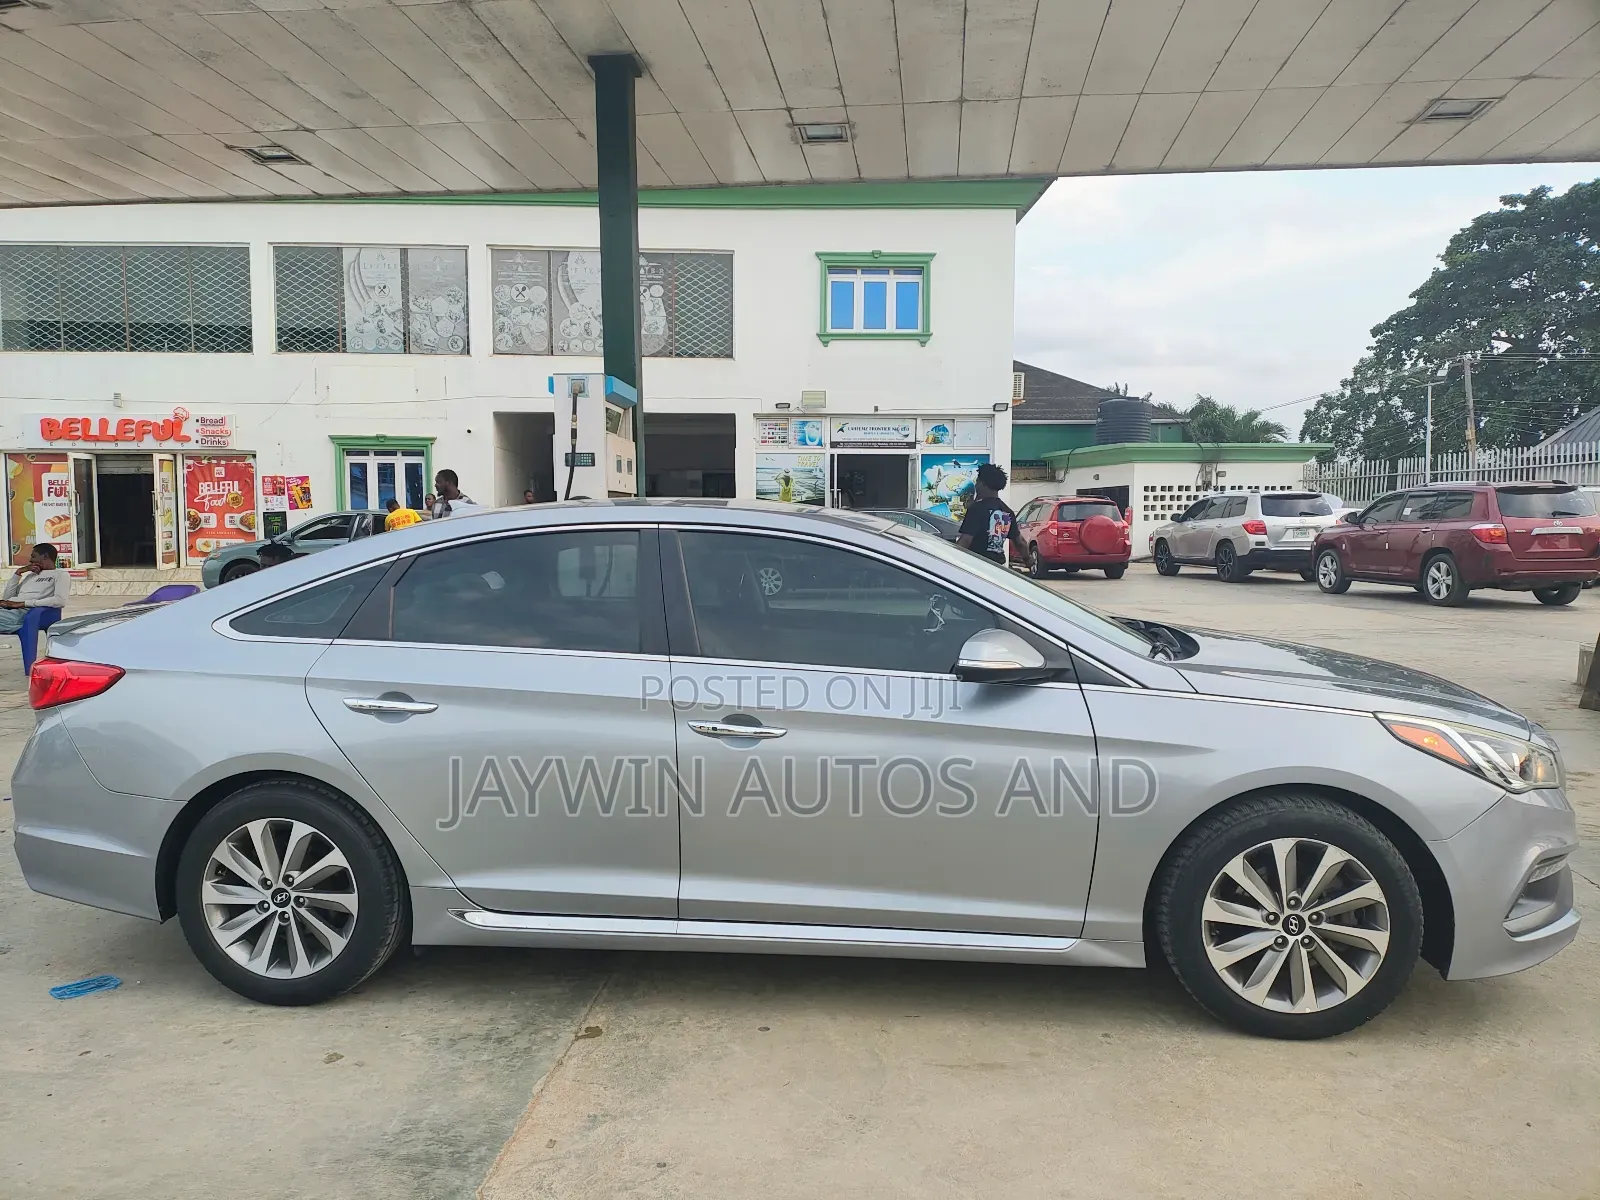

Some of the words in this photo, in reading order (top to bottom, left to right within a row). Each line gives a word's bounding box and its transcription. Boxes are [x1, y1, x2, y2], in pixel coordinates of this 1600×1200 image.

[200, 416, 225, 425] Bread
[40, 417, 192, 442] BELLEFUL
[200, 428, 230, 436] Snacks
[200, 438, 227, 447] Drinks
